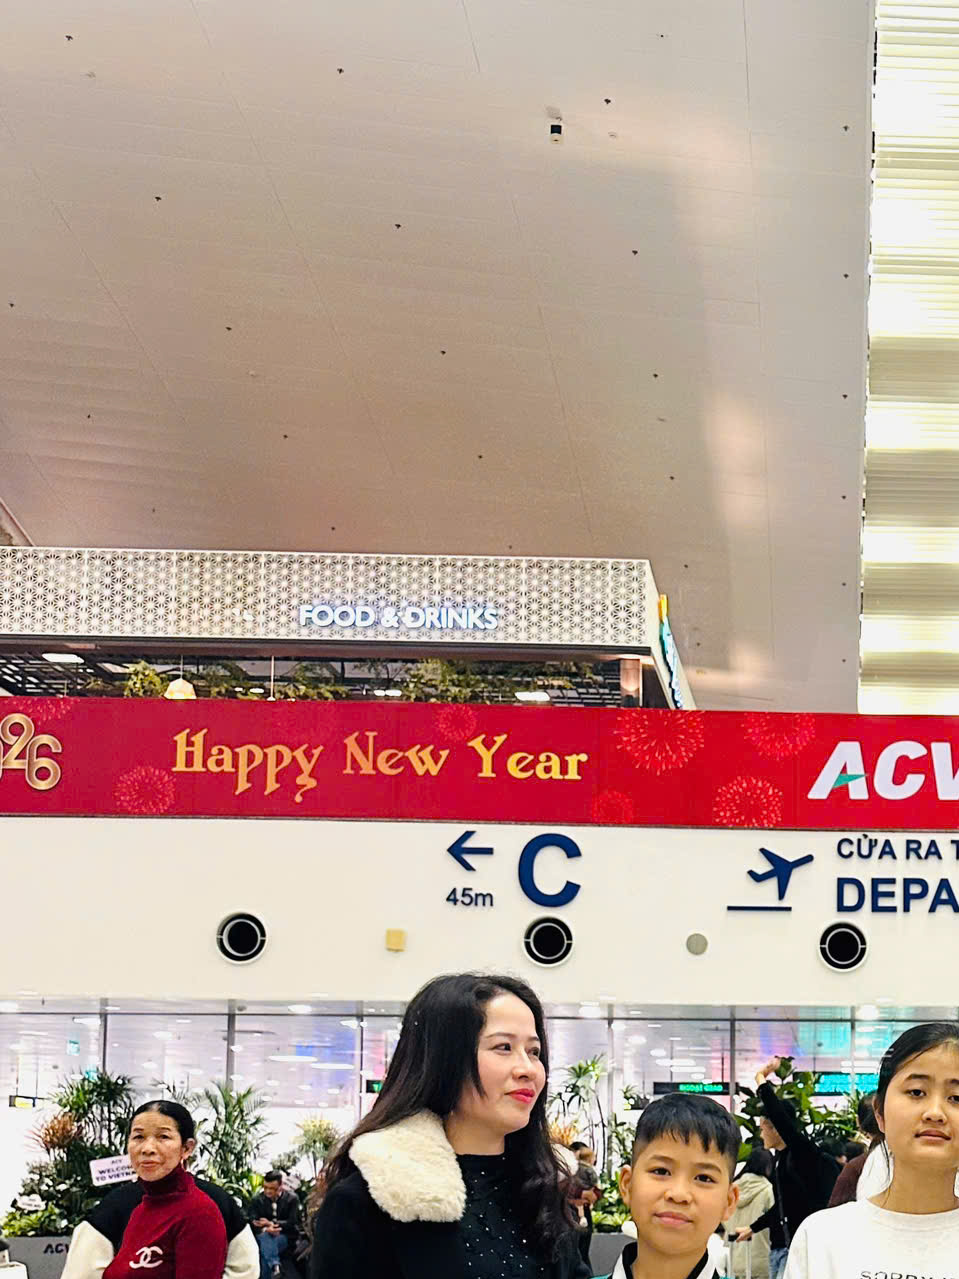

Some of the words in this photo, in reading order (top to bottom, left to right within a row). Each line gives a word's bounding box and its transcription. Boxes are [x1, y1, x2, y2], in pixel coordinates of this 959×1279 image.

[300, 604, 376, 627] FOOD
[381, 607, 399, 628] &
[403, 606, 499, 630] DRINKS
[0, 713, 62, 791] 26
[171, 728, 323, 803] Happy
[342, 731, 450, 776] New
[467, 733, 588, 780] Year
[518, 833, 582, 908] C
[836, 833, 897, 860] CỬA
[905, 839, 943, 860] RA
[446, 887, 494, 907] 45m
